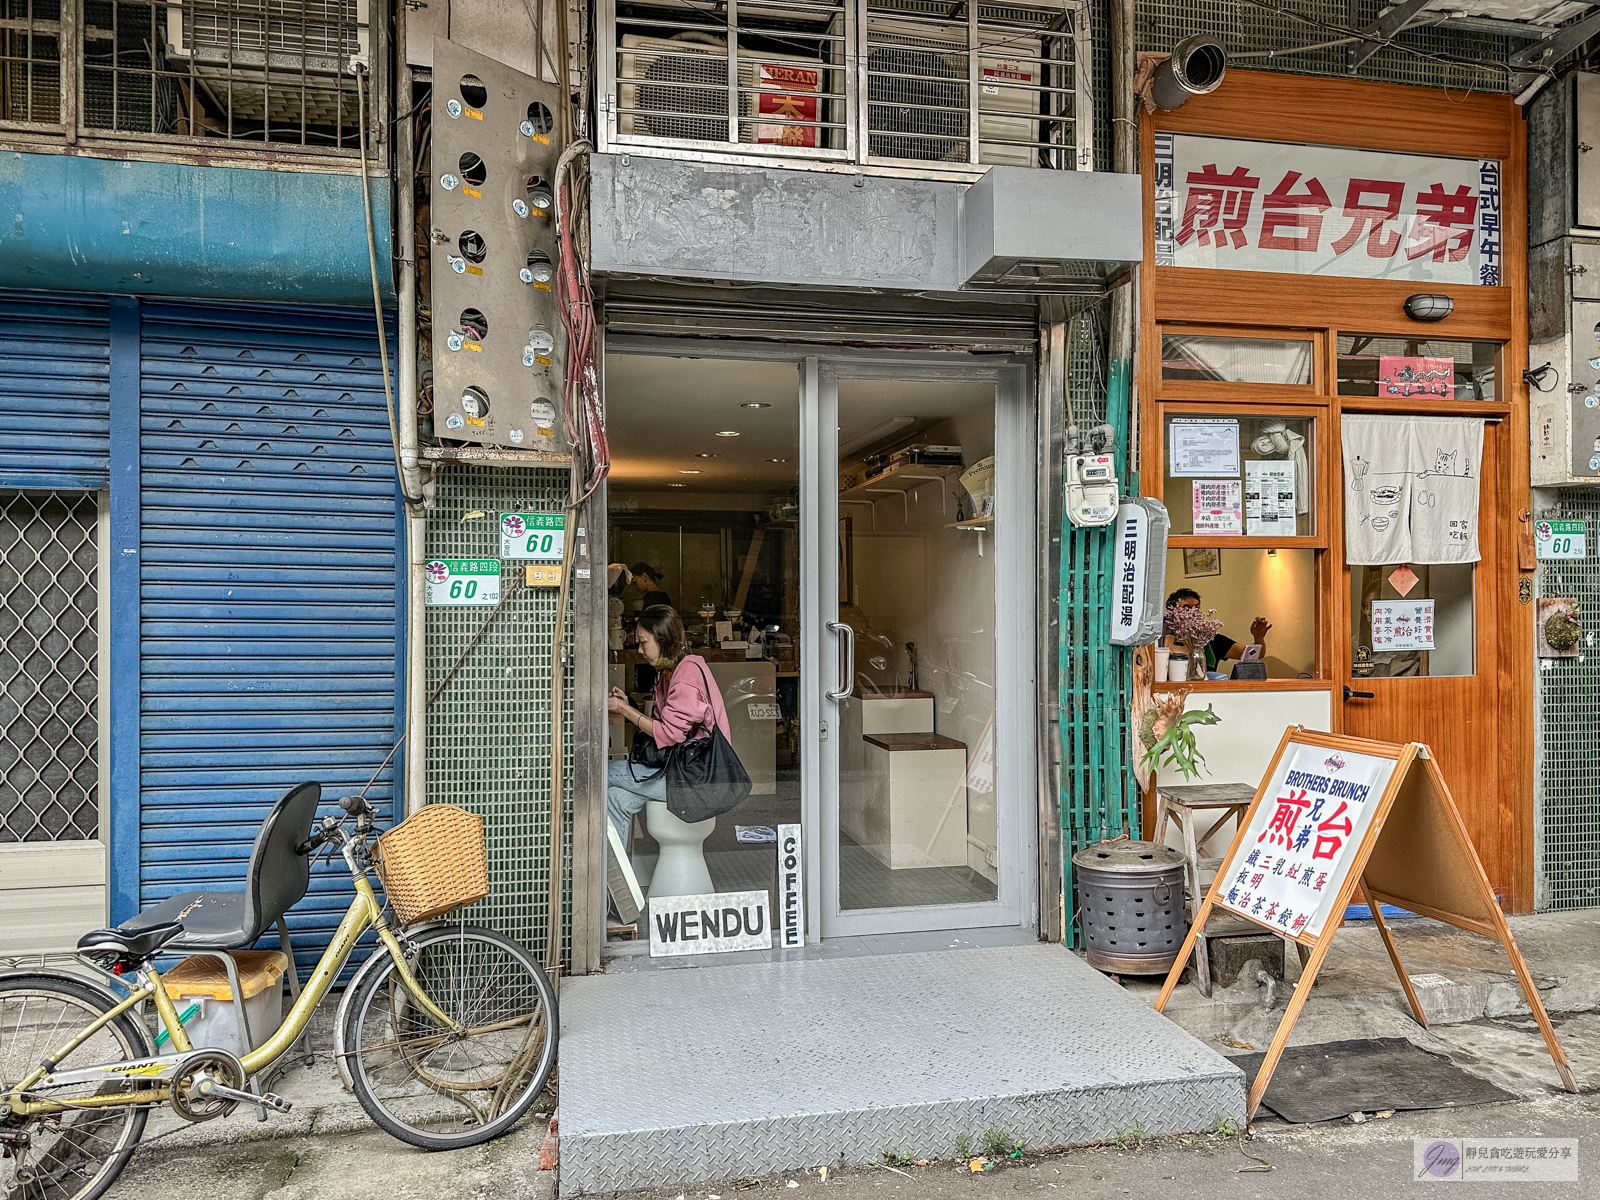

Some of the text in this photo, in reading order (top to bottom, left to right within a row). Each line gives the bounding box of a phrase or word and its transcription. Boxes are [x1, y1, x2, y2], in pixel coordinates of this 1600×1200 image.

[1174, 163, 1480, 263] 煎台兄弟
[1480, 161, 1499, 286] 台式早午餐
[1449, 520, 1469, 530] 回家
[1449, 531, 1469, 541] 吃飯
[1552, 522, 1584, 532] 信義路四段
[526, 534, 553, 553] 60
[1552, 538, 1571, 553] 60
[450, 561, 499, 573] 信義路四段
[449, 580, 477, 599] 60
[1414, 606, 1424, 643] 營養好吃
[1424, 606, 1434, 643] 經濟實惠
[1285, 770, 1370, 803] BROTHERS BRUNCH
[783, 837, 798, 945] COFFEE
[655, 905, 764, 943] WENDU
[335, 933, 350, 958] GIANT
[111, 1062, 157, 1072] GIANT
